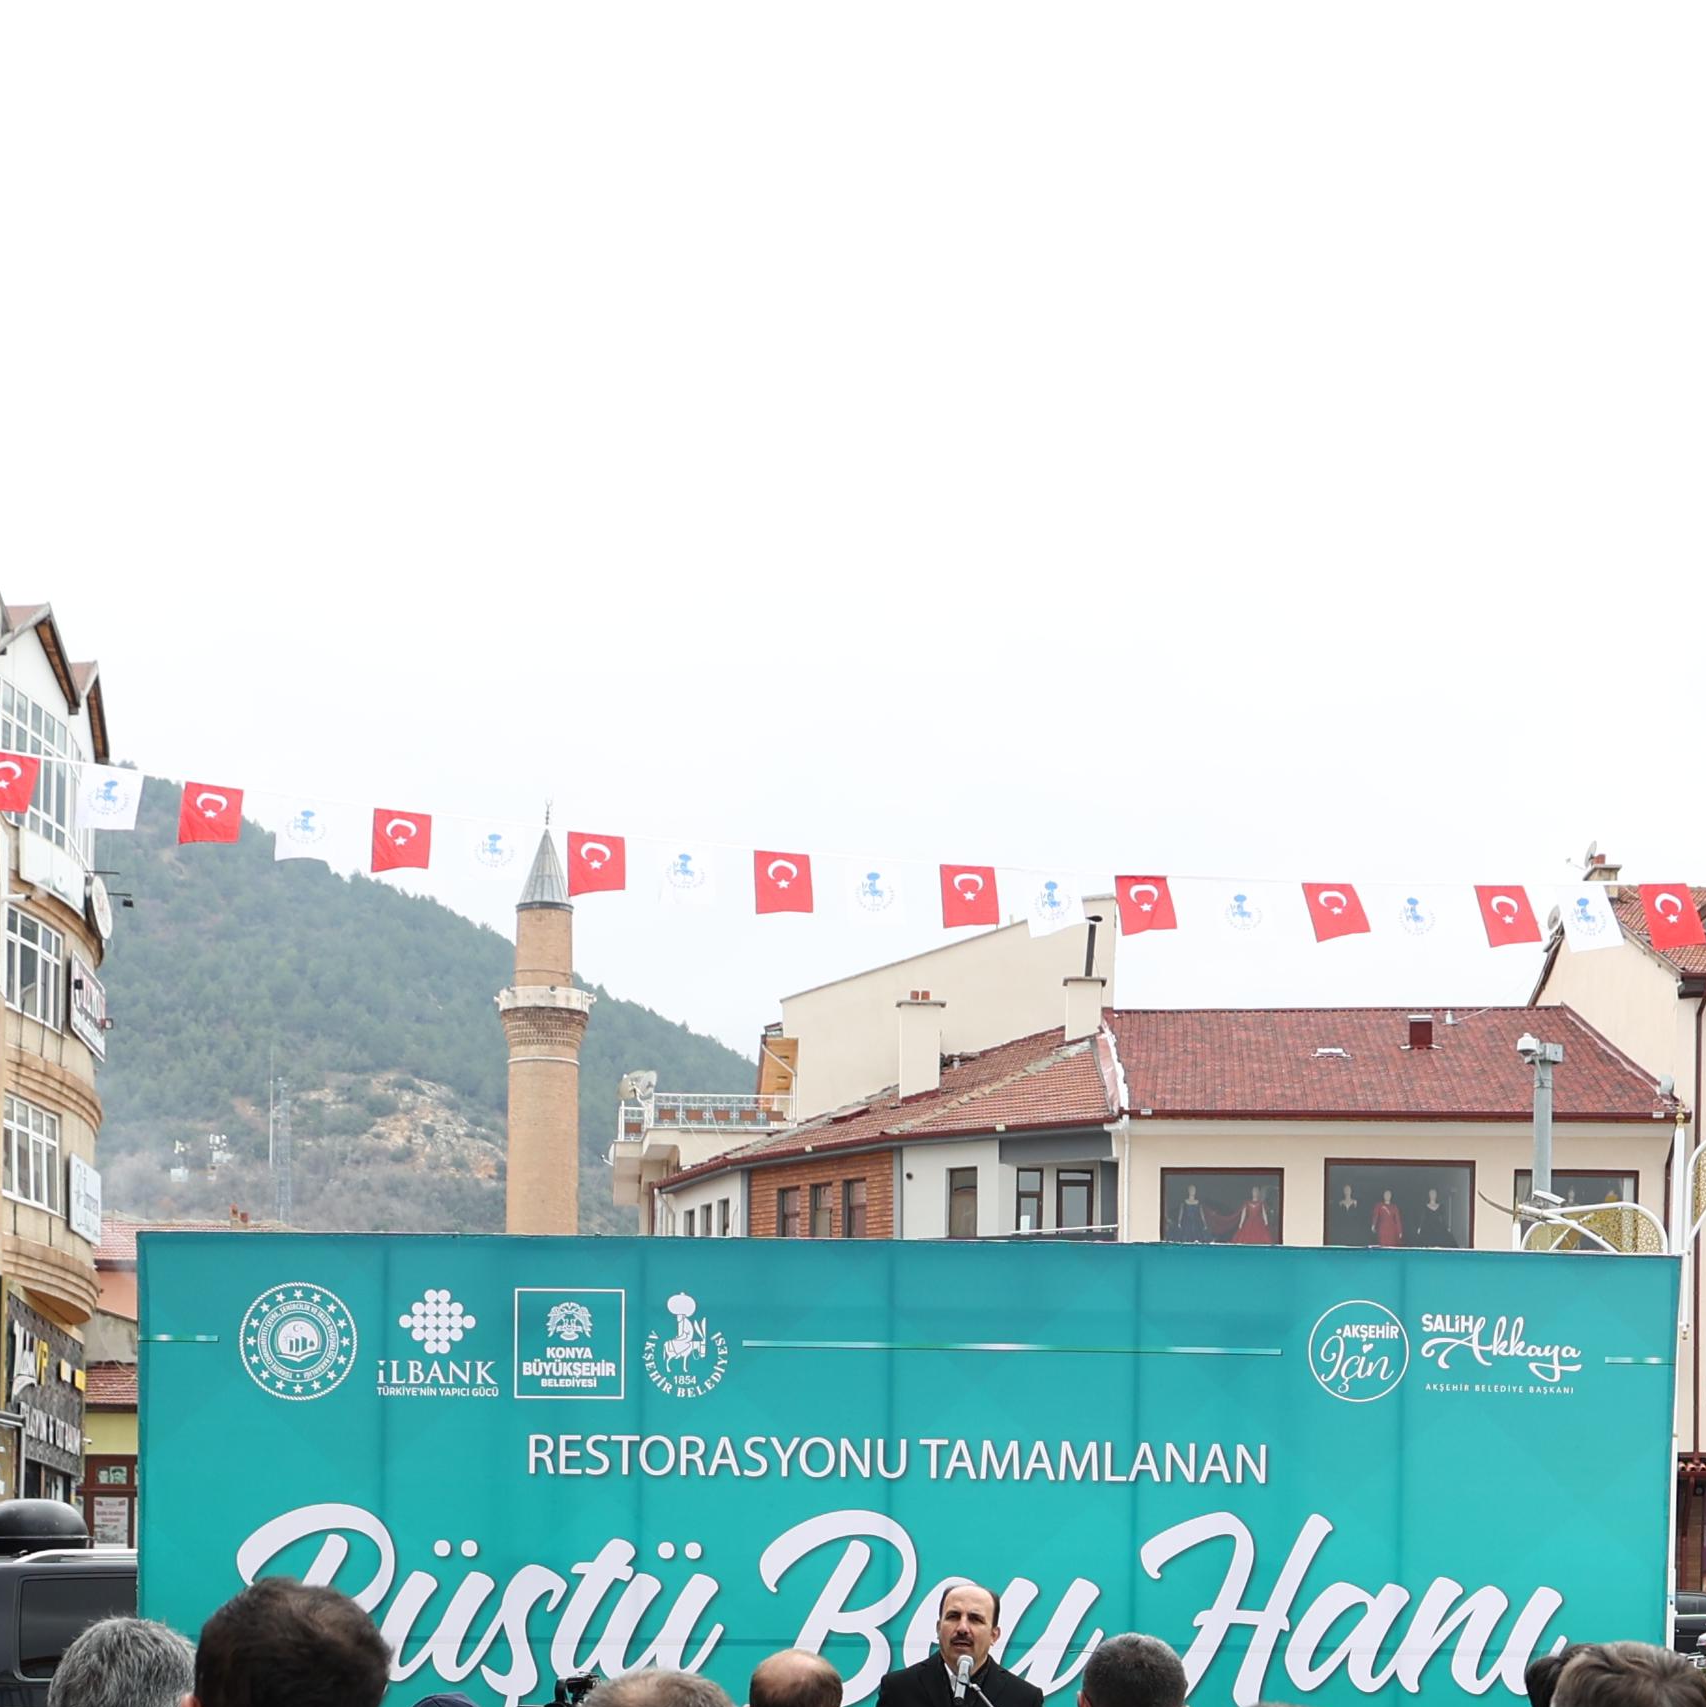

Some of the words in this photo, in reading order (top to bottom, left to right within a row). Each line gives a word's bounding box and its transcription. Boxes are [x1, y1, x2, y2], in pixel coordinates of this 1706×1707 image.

[1421, 1313, 1474, 1333] SALİH
[1342, 1321, 1400, 1343] AKŞEHİR
[545, 1346, 593, 1361] KONYA
[1420, 1316, 1583, 1383] Akkaya
[522, 1358, 616, 1379] BÜYÜKŞEHİR
[540, 1376, 598, 1388] BELEDİYESİ
[674, 1375, 697, 1385] 1854
[1425, 1382, 1470, 1392] AKŞEHİR
[1475, 1383, 1524, 1394] BELEDİYE
[1529, 1385, 1575, 1395] BAŞKANI
[377, 1385, 436, 1397] TÜRKİYE'NİN
[438, 1386, 470, 1397] YAPICI
[471, 1386, 500, 1397] GÜCÜ
[526, 1434, 909, 1478] RESTORASYONU
[919, 1438, 1269, 1485] TAMAMLANAN
